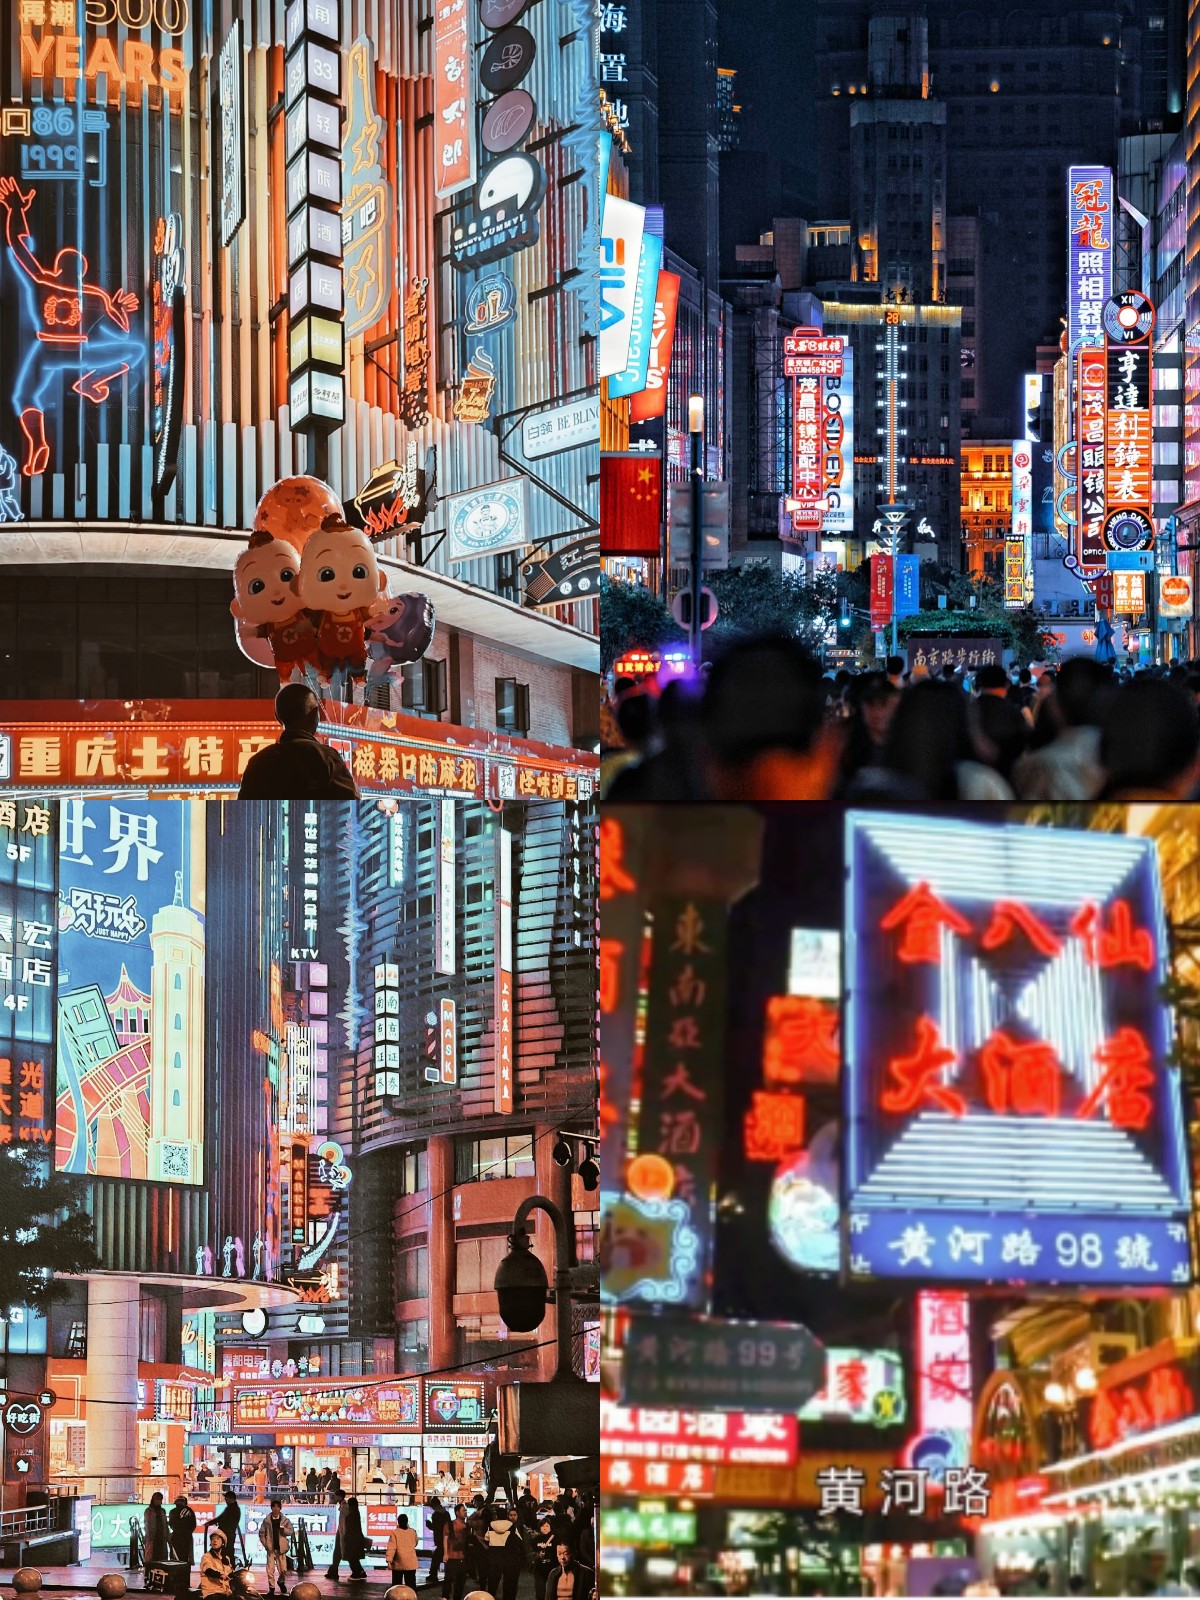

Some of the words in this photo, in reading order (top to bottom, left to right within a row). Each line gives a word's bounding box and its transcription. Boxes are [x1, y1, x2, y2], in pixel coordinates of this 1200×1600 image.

[21, 35, 188, 91] YEARS
[21, 144, 82, 169] 1999
[454, 220, 527, 262] YUMMY!
[1121, 295, 1135, 304] XII
[886, 312, 899, 324] 28
[1123, 330, 1134, 340] VI
[827, 359, 841, 373] 9F
[528, 421, 552, 440] 白领
[557, 415, 570, 431] BE
[798, 377, 817, 499] 茂昌眼镜验配中心
[1107, 511, 1128, 528] HENG
[1130, 512, 1147, 529] DALI
[913, 646, 997, 666] 南京路步行街
[352, 745, 477, 790] 磁器口陈麻花
[519, 767, 578, 800] 怪味胡豆
[6, 843, 32, 863] 5F
[291, 948, 319, 959] KTV
[4, 994, 29, 1012] 4F
[444, 1010, 453, 1073] MASK
[292, 1158, 304, 1228] MARKET
[6, 1412, 41, 1425] 好吃街
